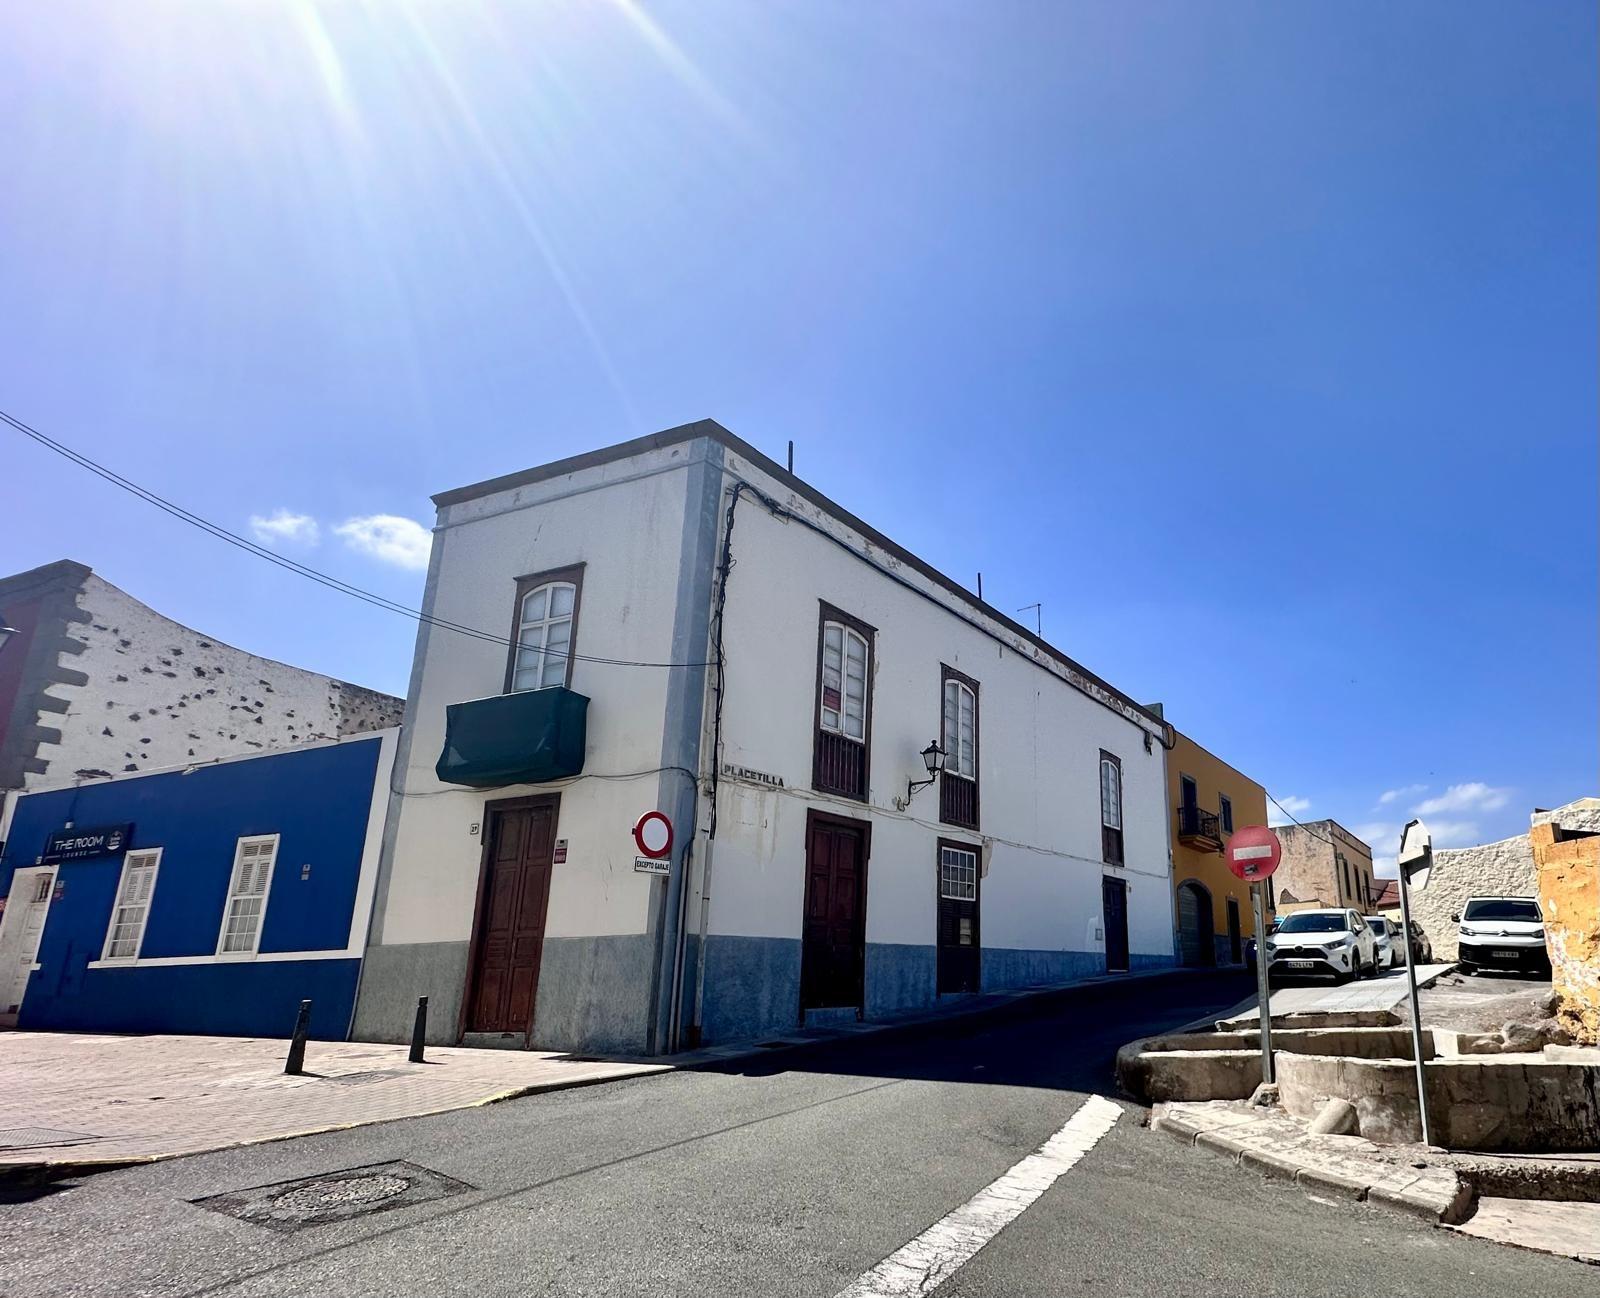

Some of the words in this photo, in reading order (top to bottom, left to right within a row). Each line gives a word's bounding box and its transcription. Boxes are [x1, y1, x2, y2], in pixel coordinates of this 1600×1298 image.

[724, 765, 784, 787] PLACETILLA
[55, 840, 74, 851] THE
[74, 836, 104, 849] ROOM
[636, 861, 655, 869] EXCEPTO
